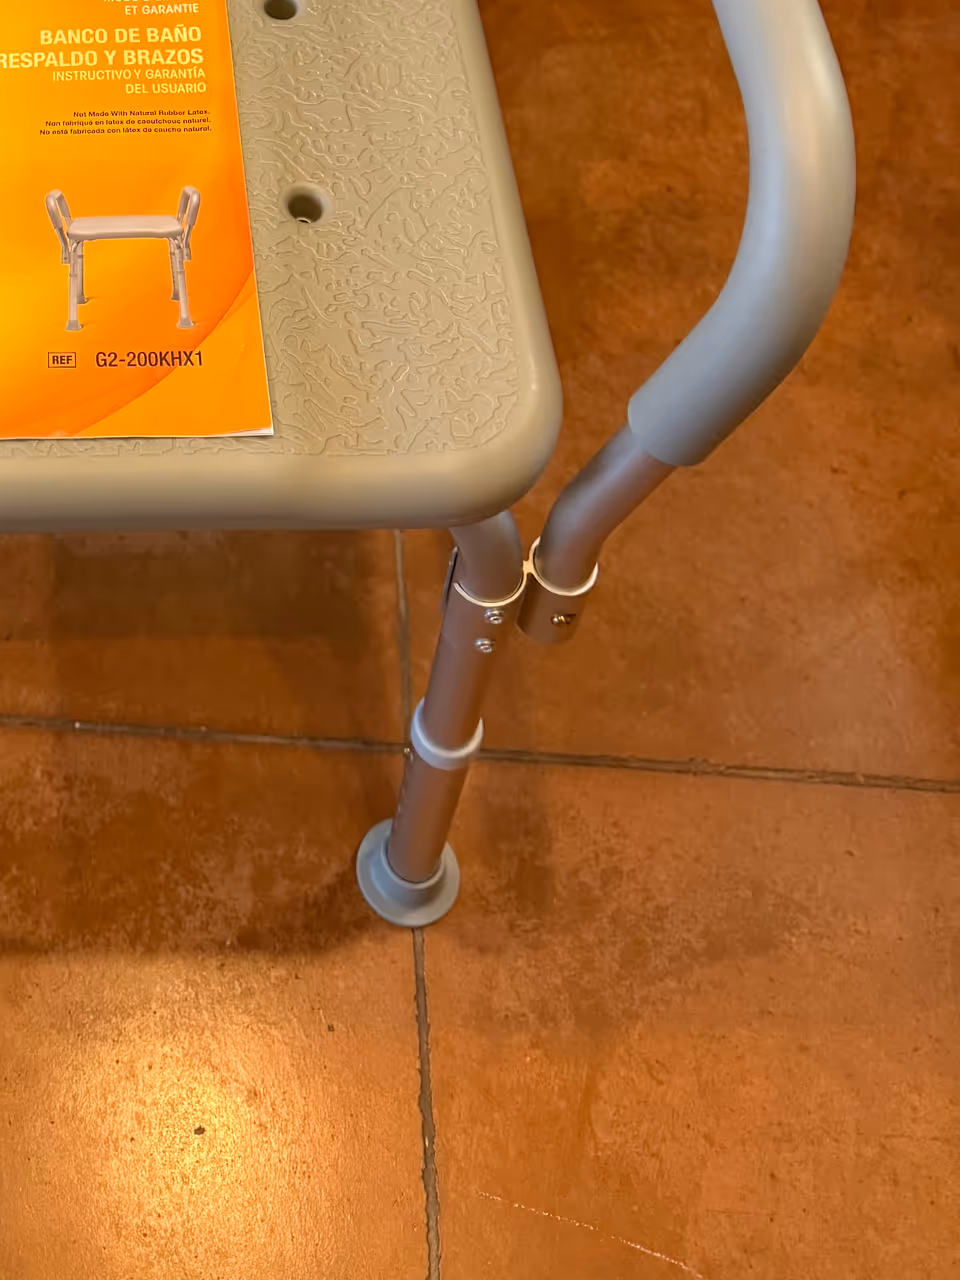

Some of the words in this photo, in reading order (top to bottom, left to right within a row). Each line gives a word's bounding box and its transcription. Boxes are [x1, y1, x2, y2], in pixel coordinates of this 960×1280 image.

[125, 5, 137, 15] ET
[141, 3, 199, 15] GARANTIE
[40, 28, 108, 45] BANCO
[115, 28, 140, 43] DE
[146, 23, 202, 43] BAÑO
[104, 50, 117, 66] Y
[123, 48, 204, 66] BRAZOS
[52, 70, 132, 81] INSTRUCTIVO
[133, 70, 141, 80] Y
[145, 66, 205, 80] GARANTÍA
[125, 83, 148, 94] DEL
[152, 82, 206, 93] USUARIO
[52, 355, 72, 365] REF
[95, 351, 203, 367] G2-200KHX1
